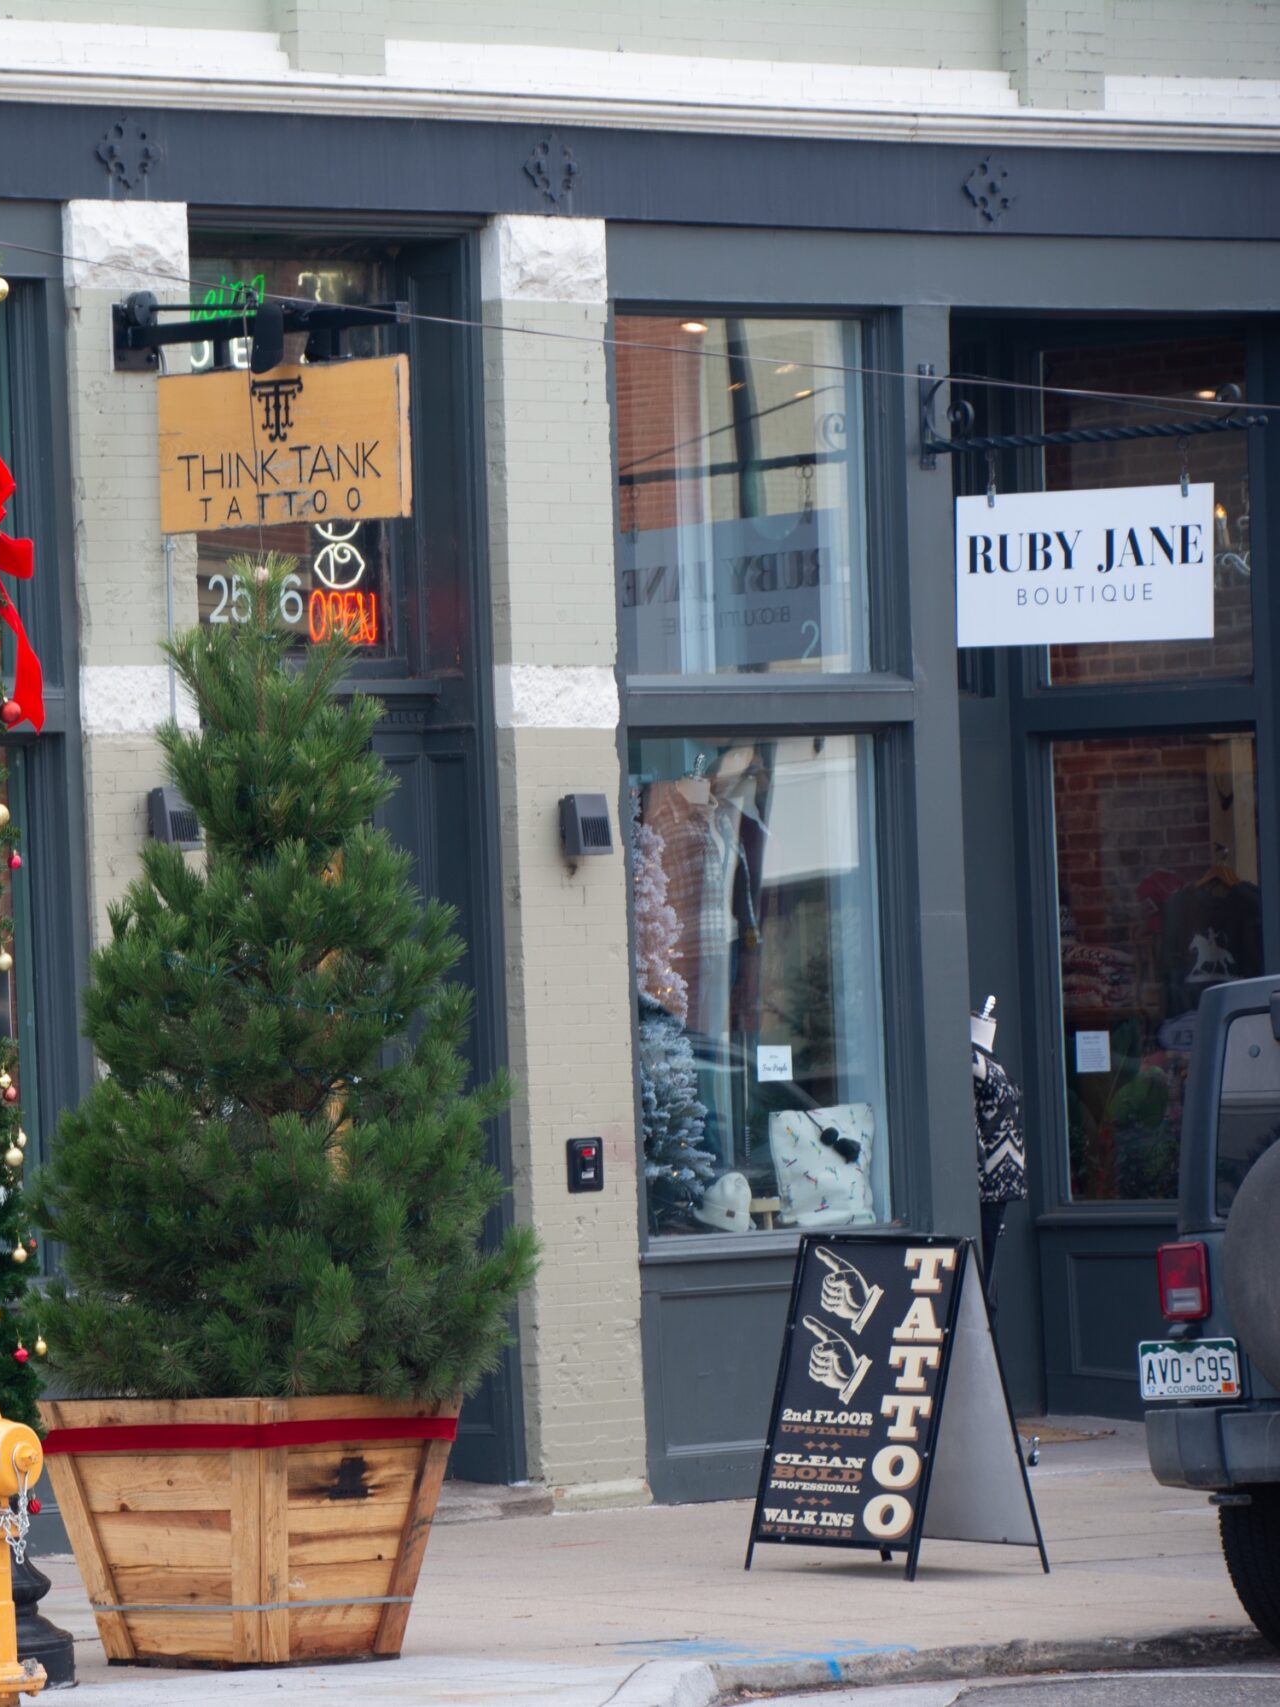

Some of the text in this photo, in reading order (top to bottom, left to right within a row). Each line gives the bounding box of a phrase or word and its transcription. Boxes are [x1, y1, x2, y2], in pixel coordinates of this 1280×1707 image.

[177, 441, 381, 491] THINK TANK
[199, 487, 361, 522] TATTOO
[967, 524, 1203, 574] RUBY JANE
[209, 574, 303, 624] 256
[1017, 583, 1153, 606] BOUTIQUE
[309, 588, 377, 643] OPEN
[863, 1248, 957, 1540] TATTOO
[1167, 1384, 1215, 1394] COLORADO
[782, 1408, 873, 1426] 2nd FLOOR
[781, 1424, 870, 1438] UPSTAIRS
[774, 1453, 866, 1469] CLEAN
[771, 1465, 863, 1482] BOLD
[770, 1480, 860, 1494] PROFESSIONAL
[763, 1508, 855, 1527] WALK INS
[761, 1524, 852, 1538] WELCOME
